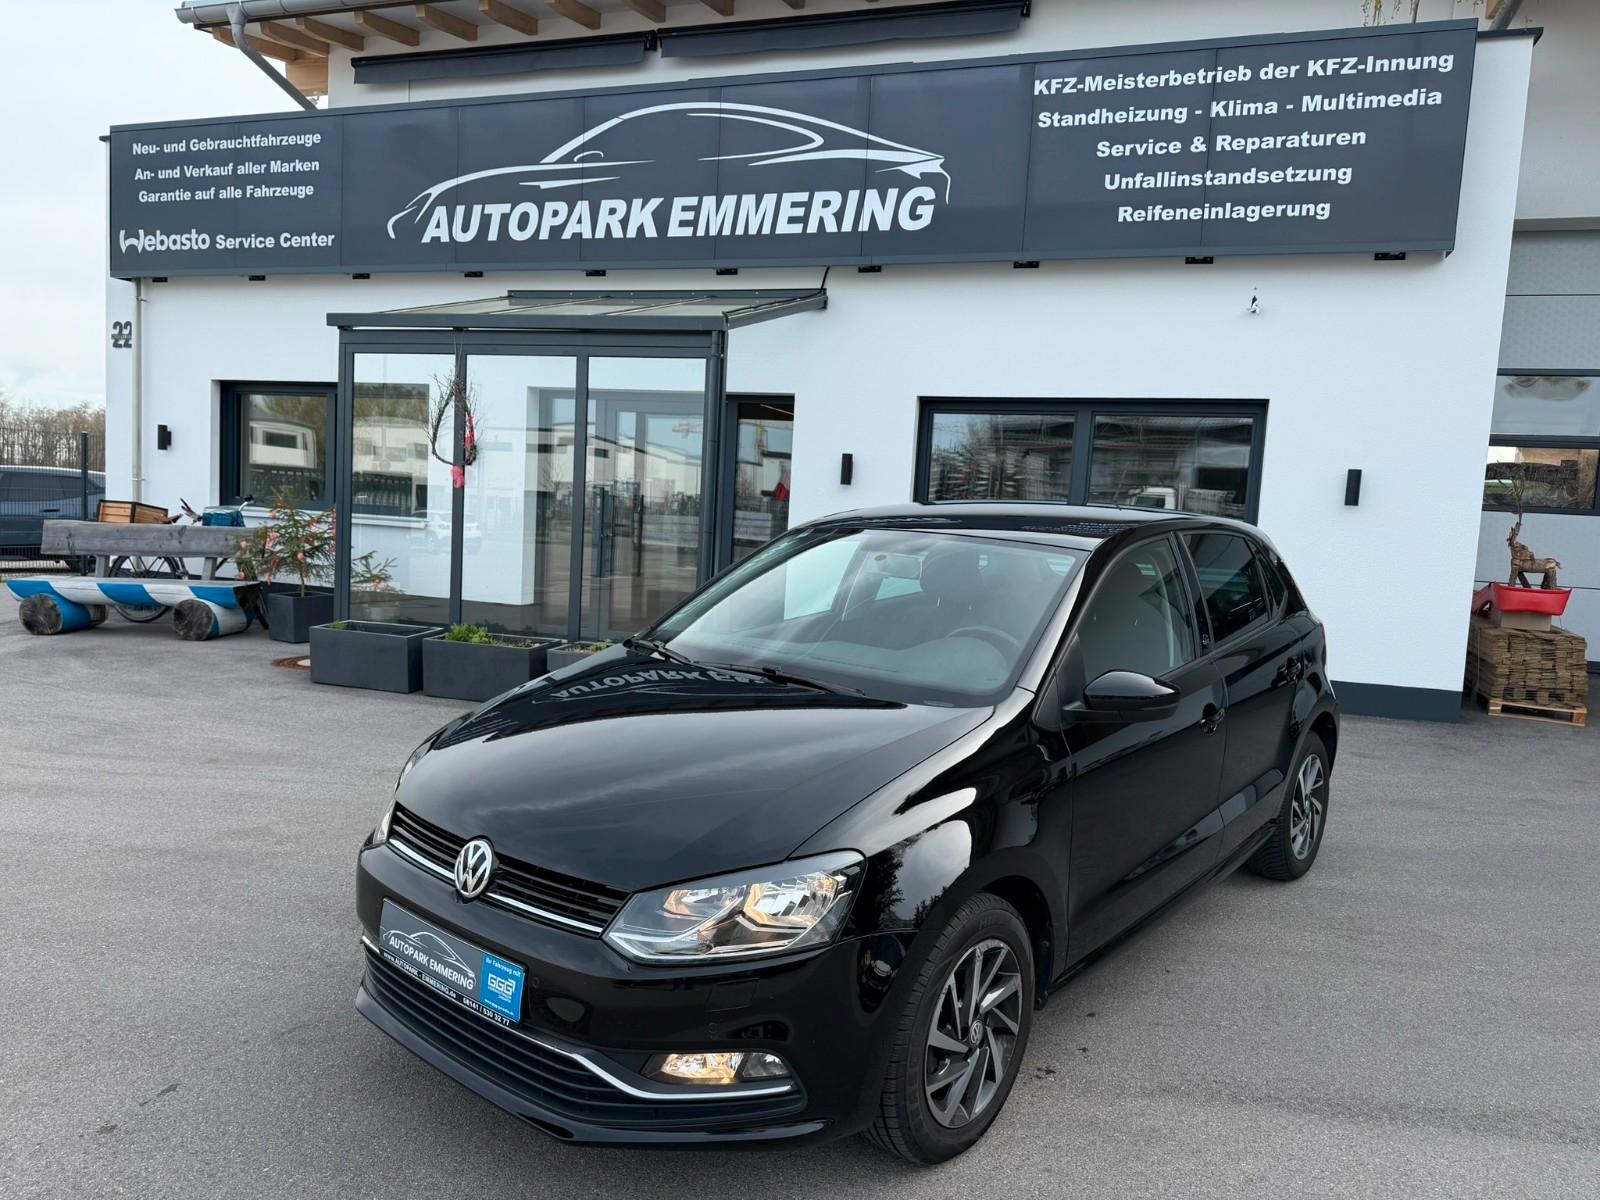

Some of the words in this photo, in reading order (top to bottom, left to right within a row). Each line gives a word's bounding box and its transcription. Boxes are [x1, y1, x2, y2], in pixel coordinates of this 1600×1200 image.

[1033, 64, 1252, 96] KFZ-Meisterbetrieb
[1259, 62, 1301, 80] der
[1307, 54, 1455, 77] KFZ-Innung
[1037, 106, 1188, 128] Standheizung
[1209, 99, 1278, 118] Klima
[1301, 88, 1442, 113] Multimedia
[132, 142, 161, 155] Neu-
[163, 139, 186, 153] und
[189, 133, 322, 152] Gebrauchtfahrzeuge
[1096, 138, 1182, 158] Service
[1190, 135, 1207, 153] &
[1215, 130, 1367, 155] Reparaturen
[134, 168, 155, 181] An-
[157, 165, 181, 179] und
[184, 162, 234, 178] Verkauf
[236, 161, 267, 175] aller
[270, 159, 320, 173] Marken
[1104, 166, 1353, 190] Unfallinstandsetzung
[138, 188, 192, 203] Garantie
[194, 186, 216, 201] auf
[218, 184, 242, 199] alle
[246, 184, 314, 199] Fahrzeuge
[420, 197, 665, 244] AUTOPARK
[666, 186, 936, 238] EMMERING
[1117, 202, 1331, 223] Reifeneinlagerung
[119, 228, 211, 255] Webasto
[215, 233, 275, 250] Service
[279, 232, 336, 248] Center
[111, 320, 133, 349] 22
[389, 936, 429, 967] AUTOPARK
[429, 958, 474, 990] EMMERING
[487, 972, 516, 996] GGG
